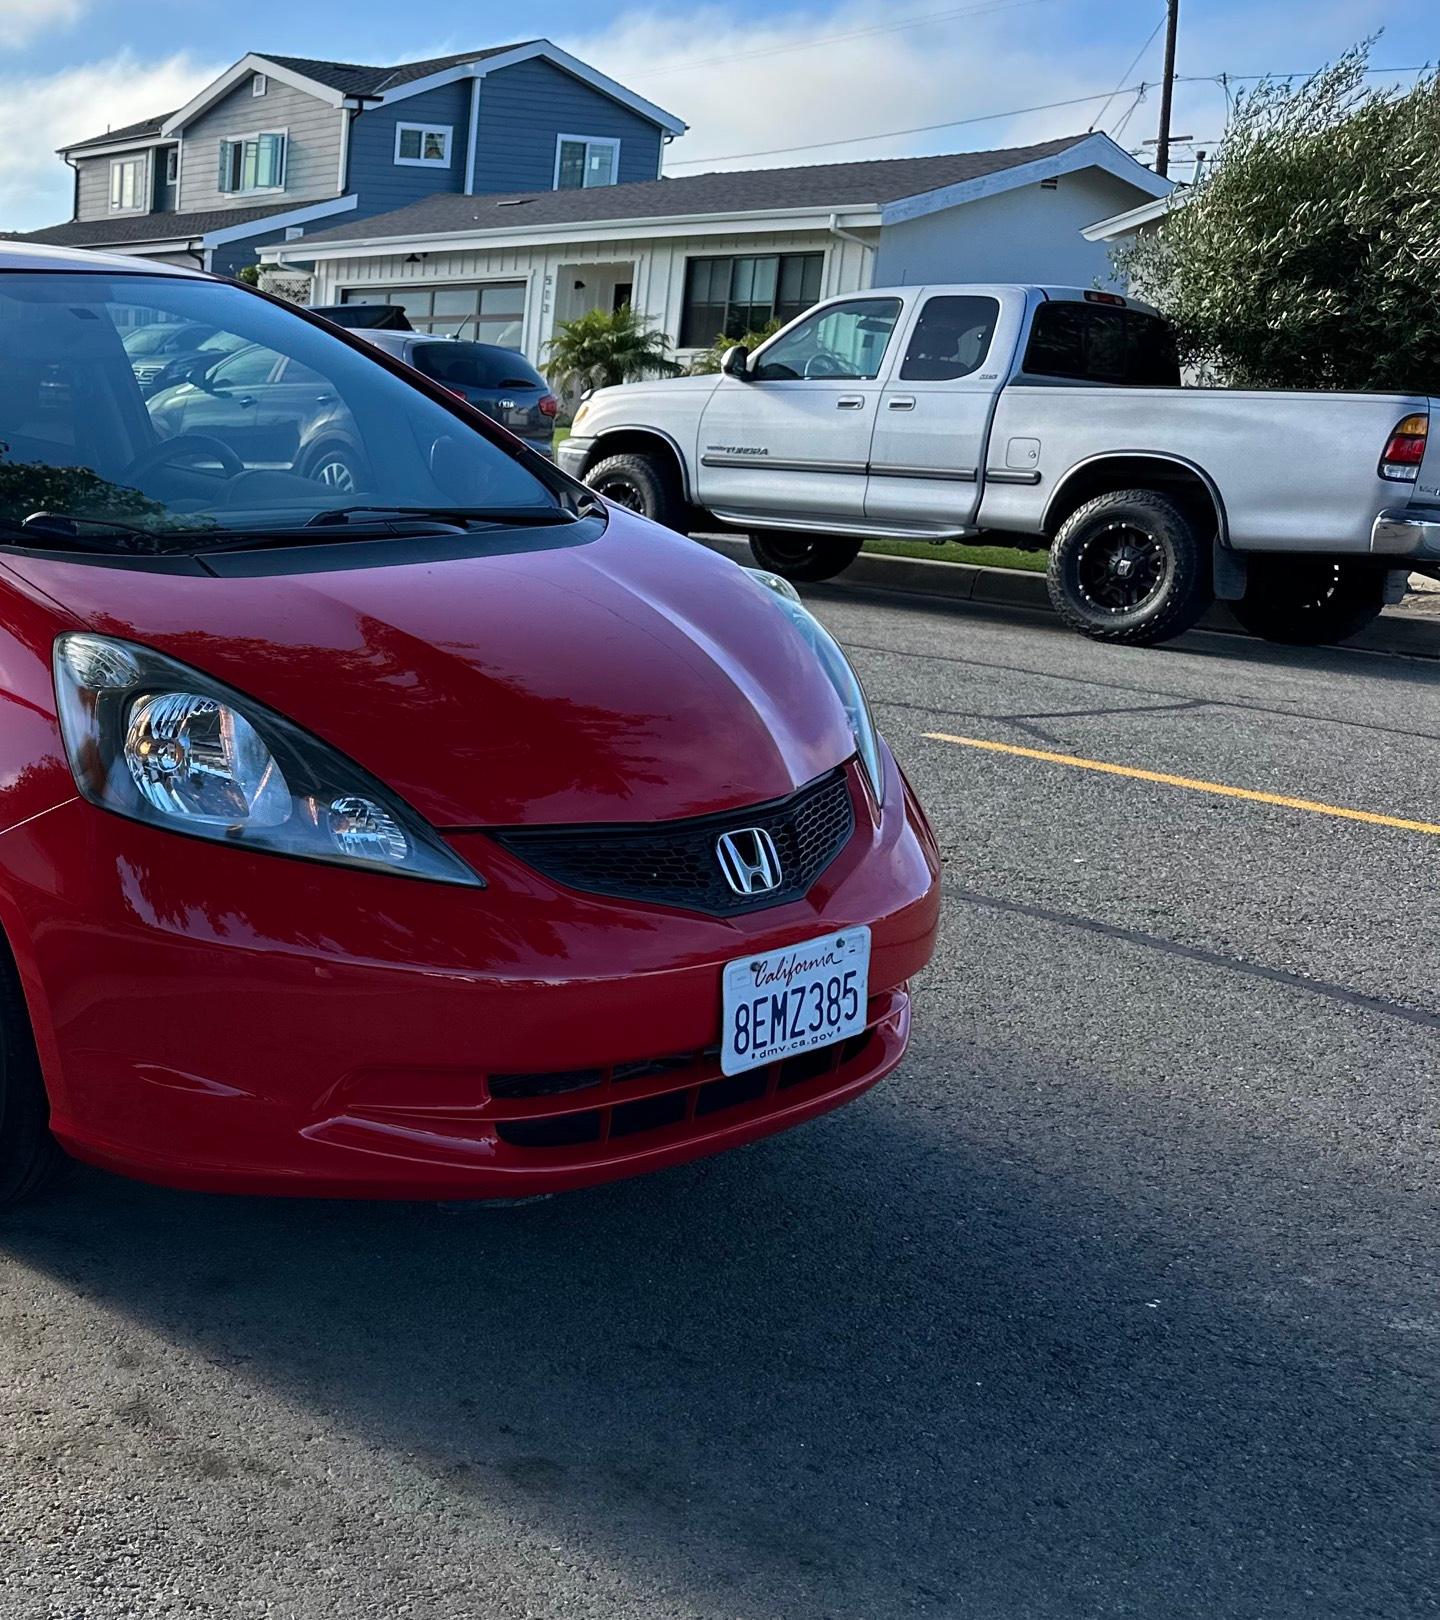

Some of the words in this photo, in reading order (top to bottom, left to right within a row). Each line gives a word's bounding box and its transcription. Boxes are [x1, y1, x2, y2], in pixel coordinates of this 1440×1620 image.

[724, 446, 769, 456] TUNDRA
[754, 949, 843, 988] California
[734, 970, 859, 1056] 8EMZ385
[759, 1030, 835, 1060] dmv.ca.gov
